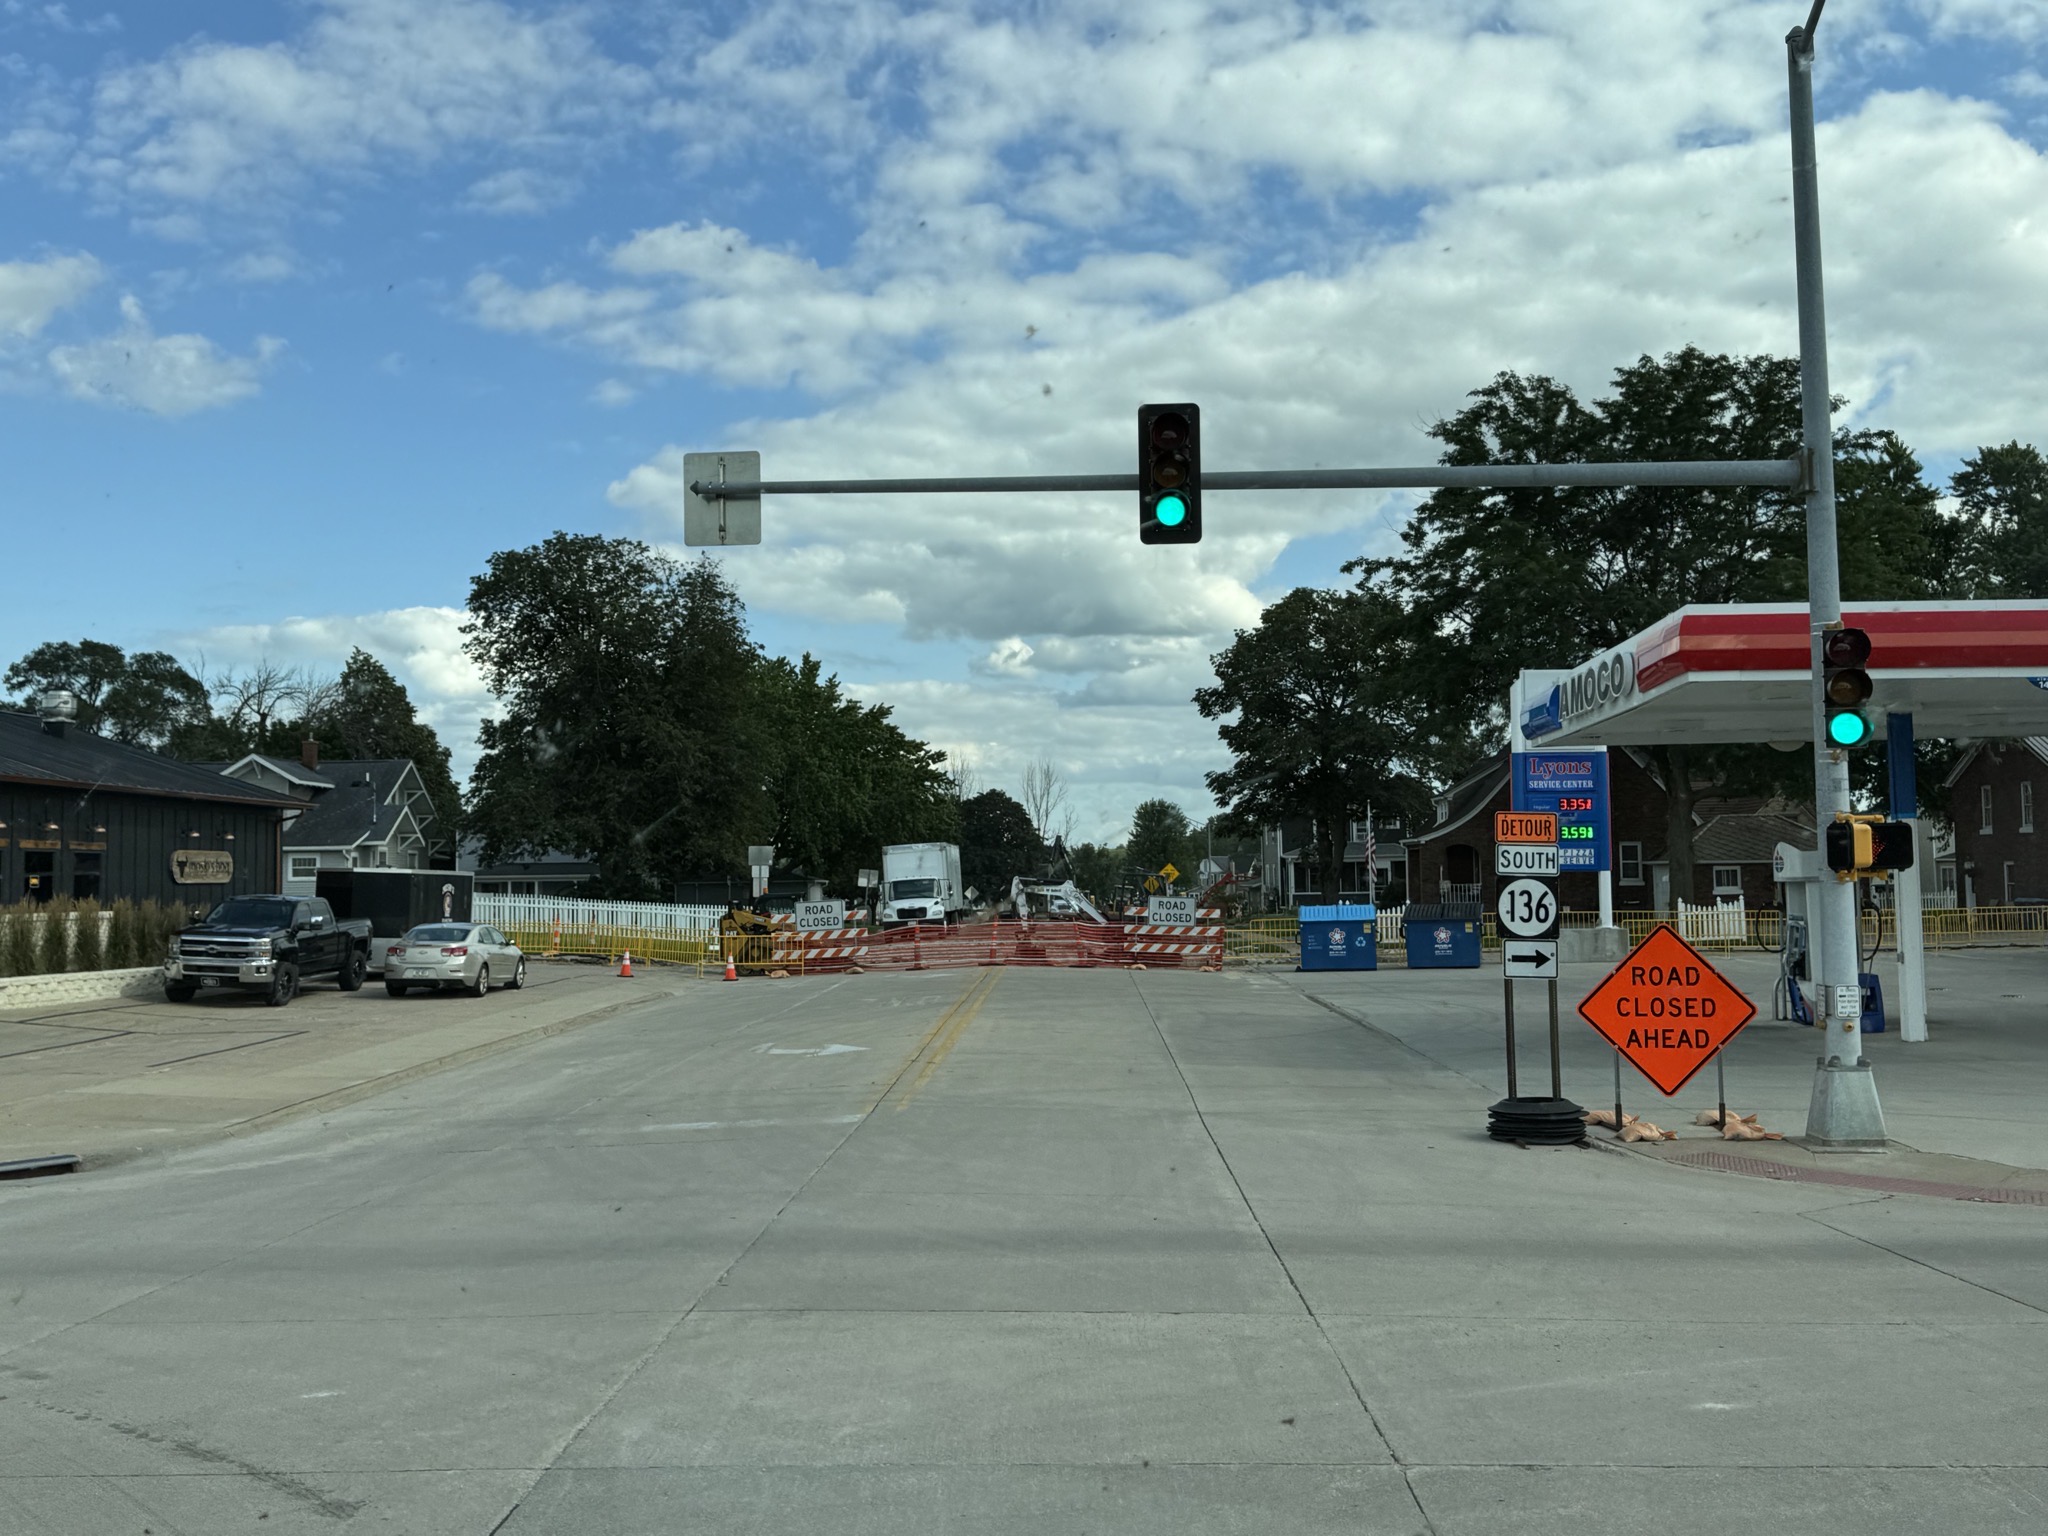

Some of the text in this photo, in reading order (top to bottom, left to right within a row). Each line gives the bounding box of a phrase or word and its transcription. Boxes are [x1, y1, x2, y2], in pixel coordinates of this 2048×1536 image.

[1559, 652, 1625, 721] AMOCO
[1530, 757, 1592, 779] Lyons
[1529, 780, 1594, 788] SERVICE CENTER
[1501, 818, 1552, 837] DETOUR
[1500, 849, 1556, 869] SOUTH
[1563, 849, 1594, 857] PIZZA
[1563, 857, 1594, 865] SERVE
[805, 904, 833, 915] ROAD
[1158, 900, 1186, 911] ROAD
[1507, 889, 1550, 923] 136
[800, 916, 840, 928] CLOSED
[1152, 912, 1192, 923] CLOSED
[1632, 966, 1700, 986] ROAD
[1616, 997, 1716, 1017] CLOSED
[1626, 1029, 1710, 1048] AHEAD
